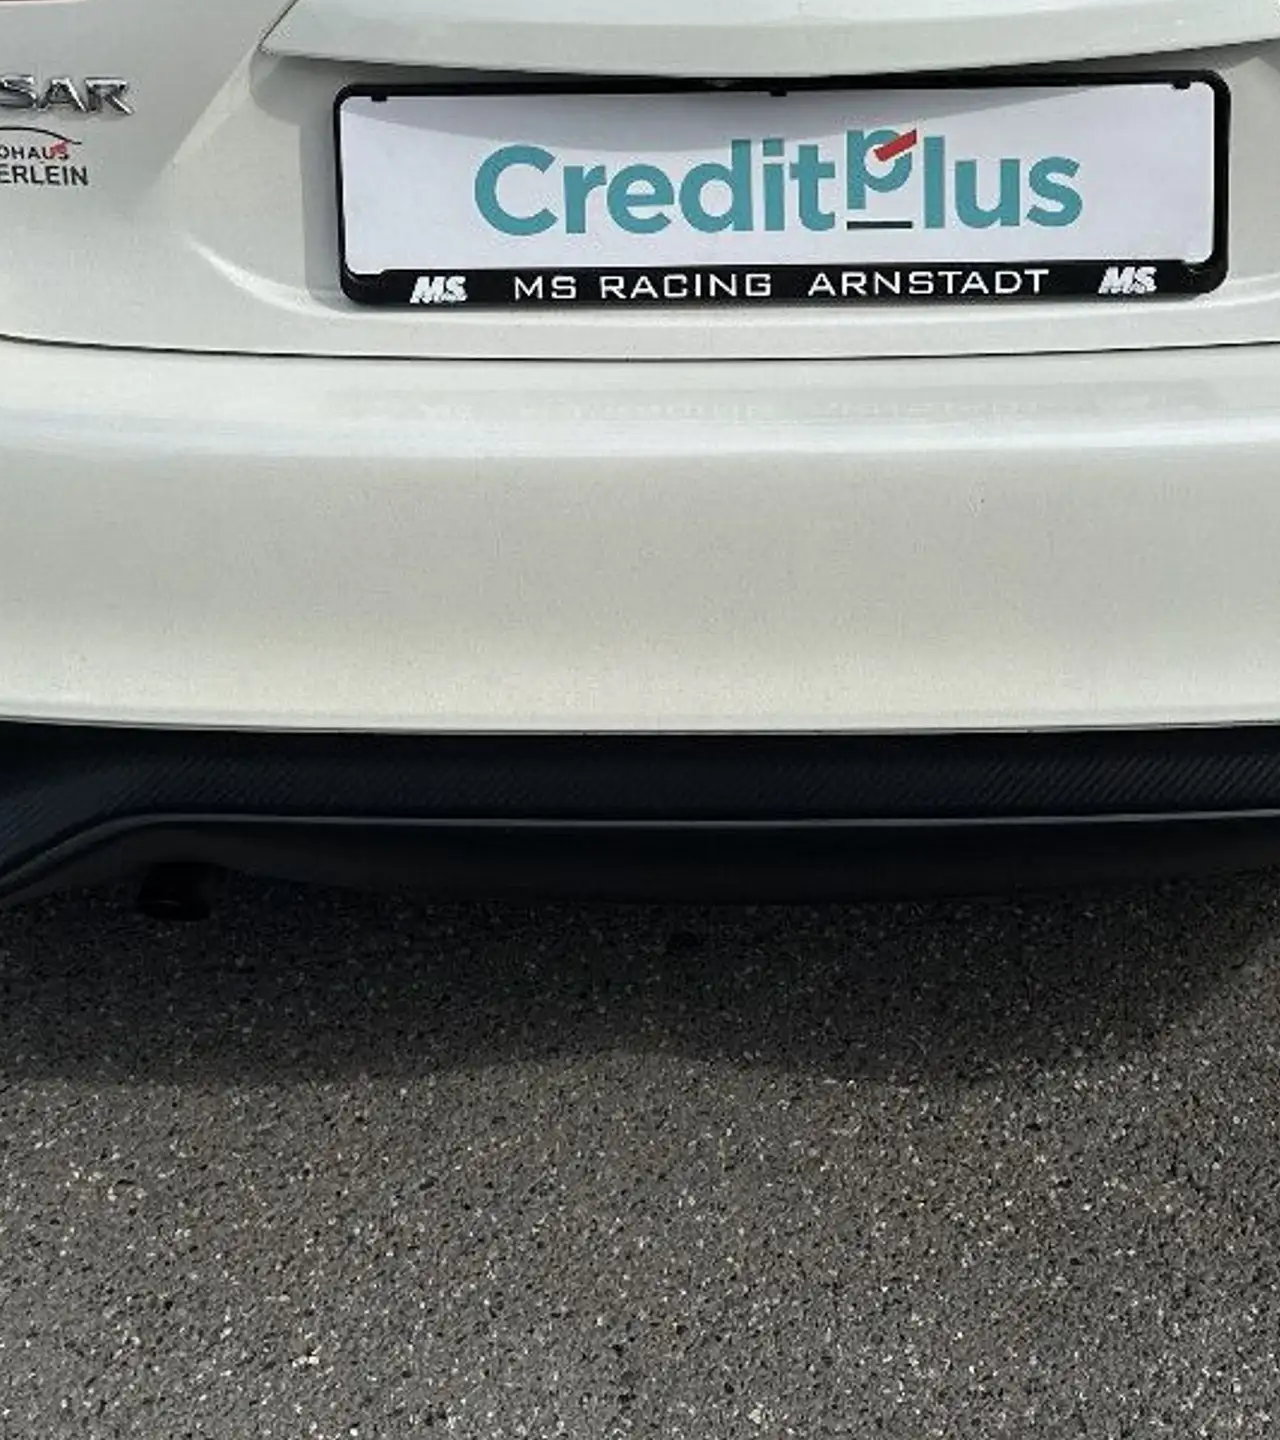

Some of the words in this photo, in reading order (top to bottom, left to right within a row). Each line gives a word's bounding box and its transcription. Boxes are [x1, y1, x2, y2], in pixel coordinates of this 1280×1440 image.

[409, 275, 469, 304] MS
[514, 276, 577, 300] MS
[600, 272, 772, 299] RACING
[807, 268, 1050, 297] ARNSTADT
[1098, 265, 1158, 295] MS
